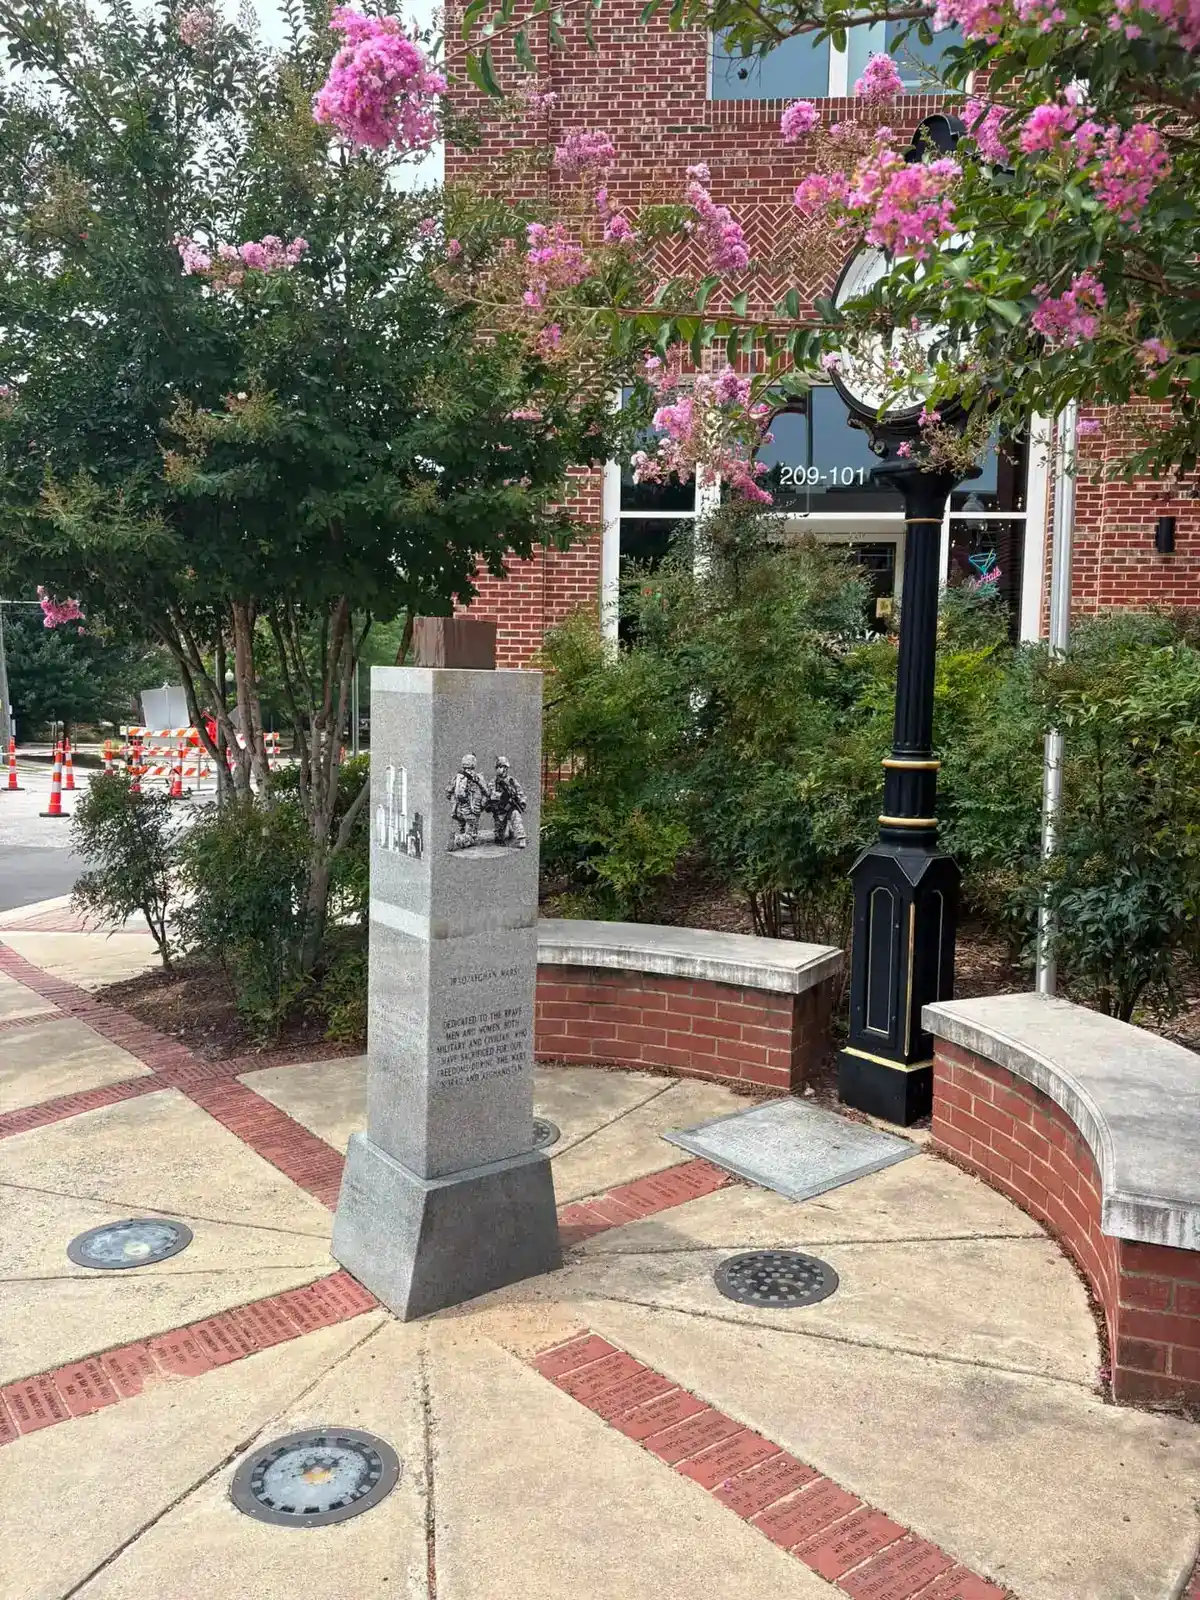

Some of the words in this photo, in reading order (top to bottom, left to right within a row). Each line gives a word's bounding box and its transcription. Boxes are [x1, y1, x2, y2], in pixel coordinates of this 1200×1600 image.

[780, 466, 864, 485] 209-101
[444, 1016, 476, 1030] DEDICATED
[479, 1013, 488, 1023] TO
[490, 1010, 501, 1021] THE
[504, 1006, 522, 1018] BRAVE
[446, 1030, 460, 1040] MEN
[462, 1027, 476, 1037] AND
[479, 1023, 500, 1034] WOMEN
[437, 1041, 465, 1053] MILITARY
[469, 1037, 482, 1048] AND
